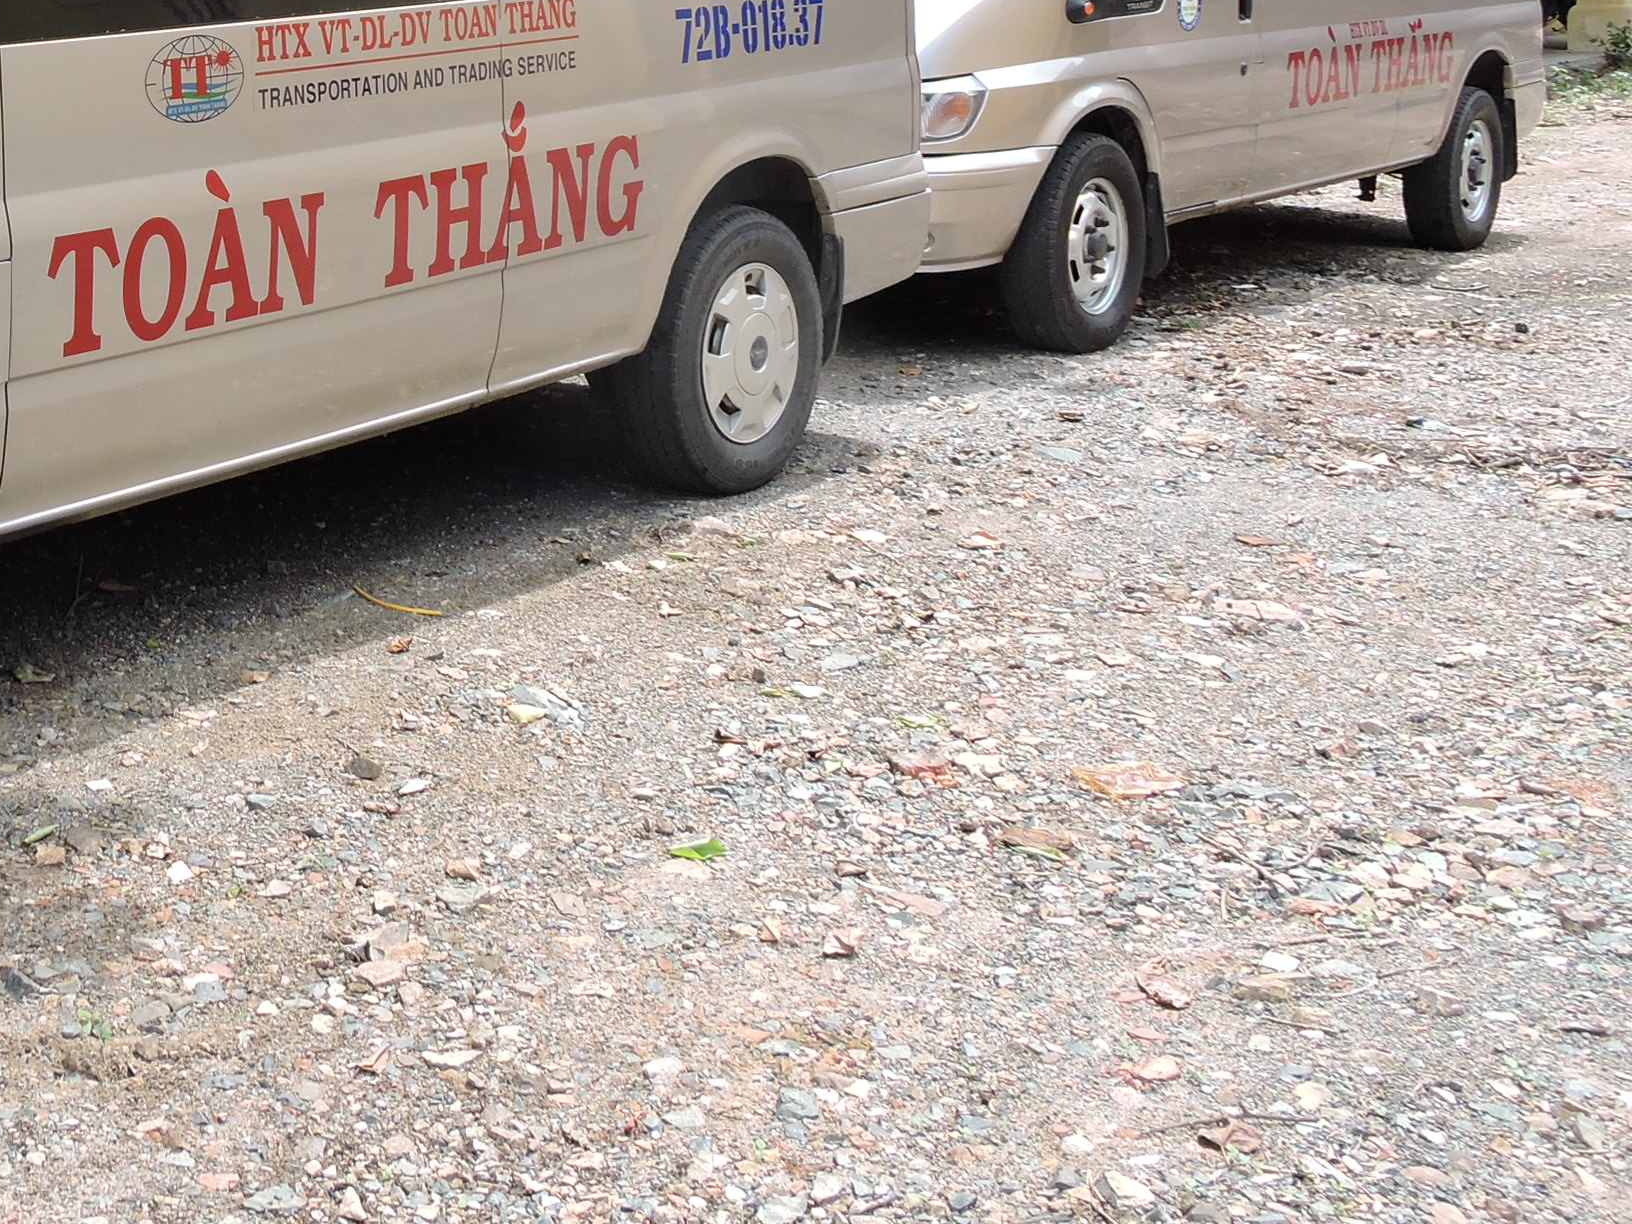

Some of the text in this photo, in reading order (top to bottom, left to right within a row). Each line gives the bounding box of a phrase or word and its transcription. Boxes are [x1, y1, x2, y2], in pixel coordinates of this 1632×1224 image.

[255, 21, 312, 63] HTX
[319, 9, 432, 55] VT-DL-DV
[439, 3, 499, 40] TOAN
[1286, 18, 1455, 109] TOÀN THẮNG
[258, 49, 578, 110] TRANSPORTATION AND TRADING SERVICE
[47, 100, 645, 358] TOÀN THẮNG
